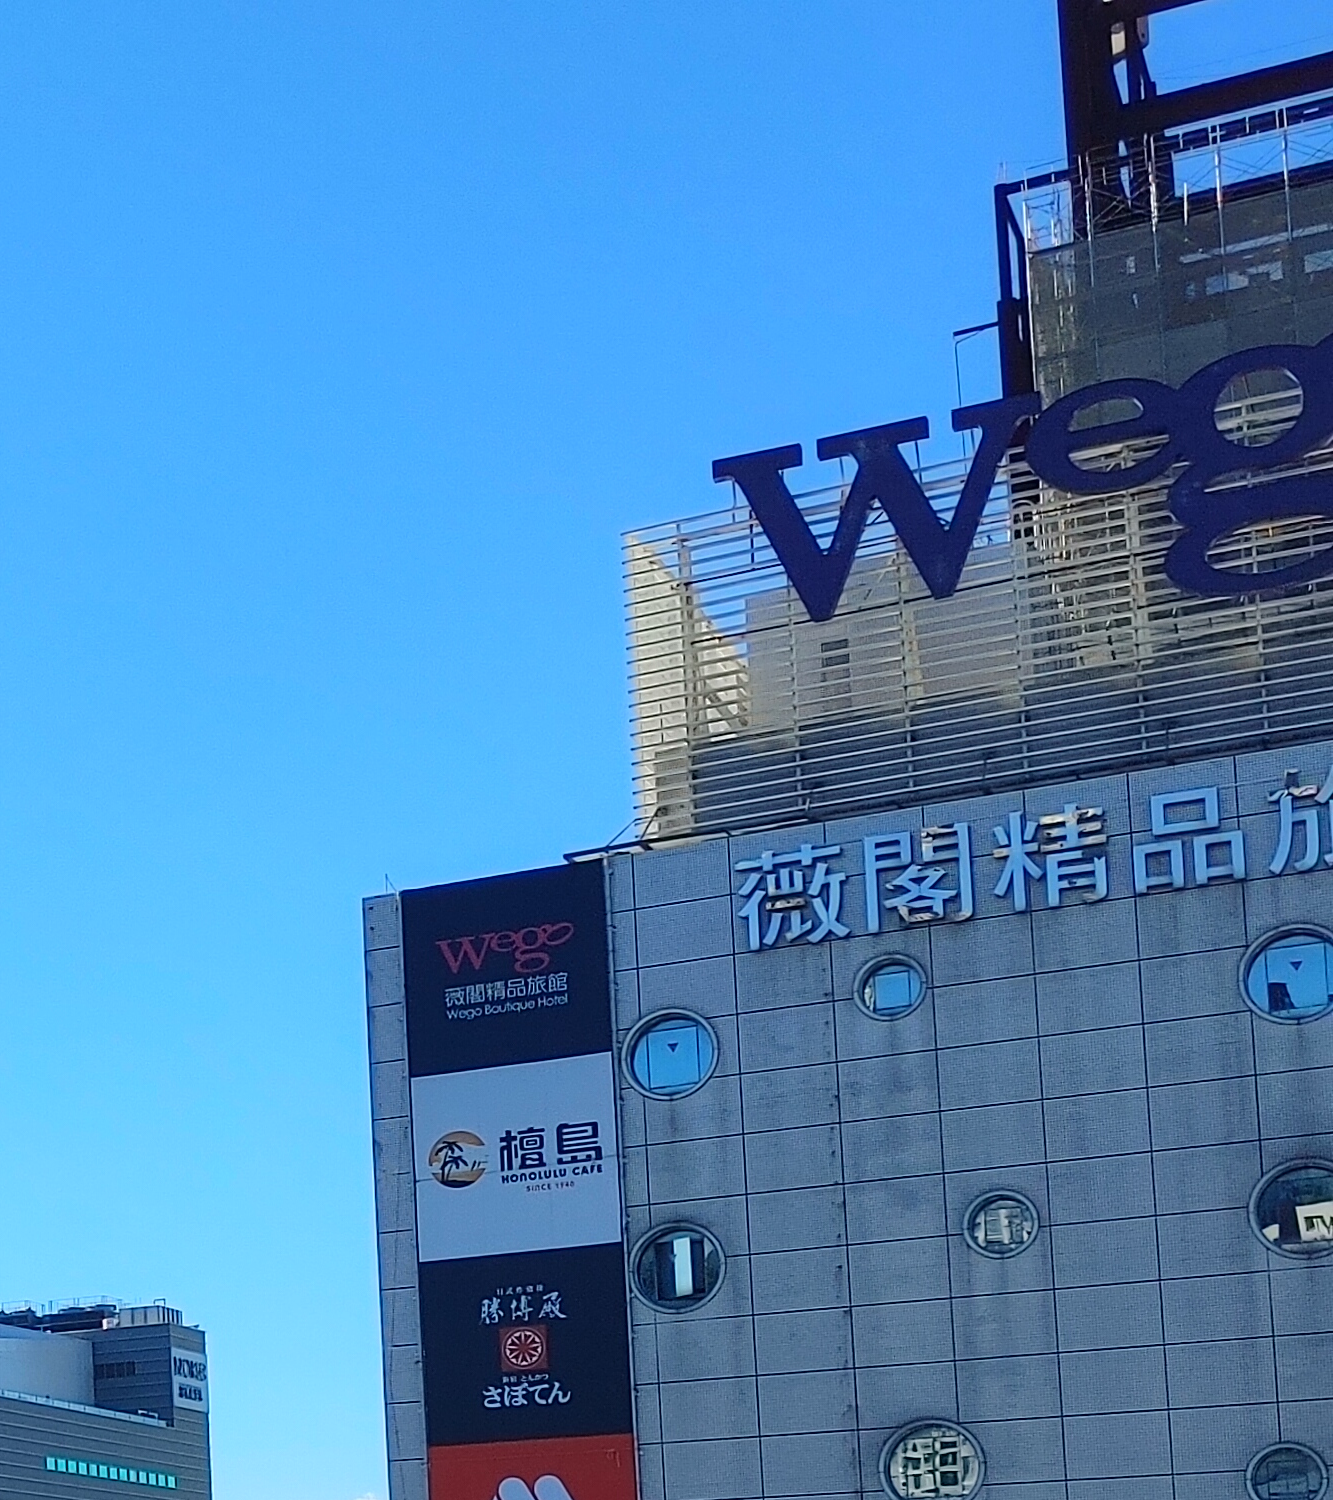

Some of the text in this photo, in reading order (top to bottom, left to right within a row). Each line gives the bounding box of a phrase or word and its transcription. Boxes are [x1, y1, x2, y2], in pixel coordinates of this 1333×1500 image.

[435, 922, 574, 974] Wego
[444, 972, 568, 1008] 薇閣精品旅館
[446, 993, 569, 1020] Wego Boutique Hotel
[499, 1121, 603, 1172] 檀島
[501, 1164, 603, 1184] HONOLULU CAFE
[482, 1382, 571, 1408] さぼてん
